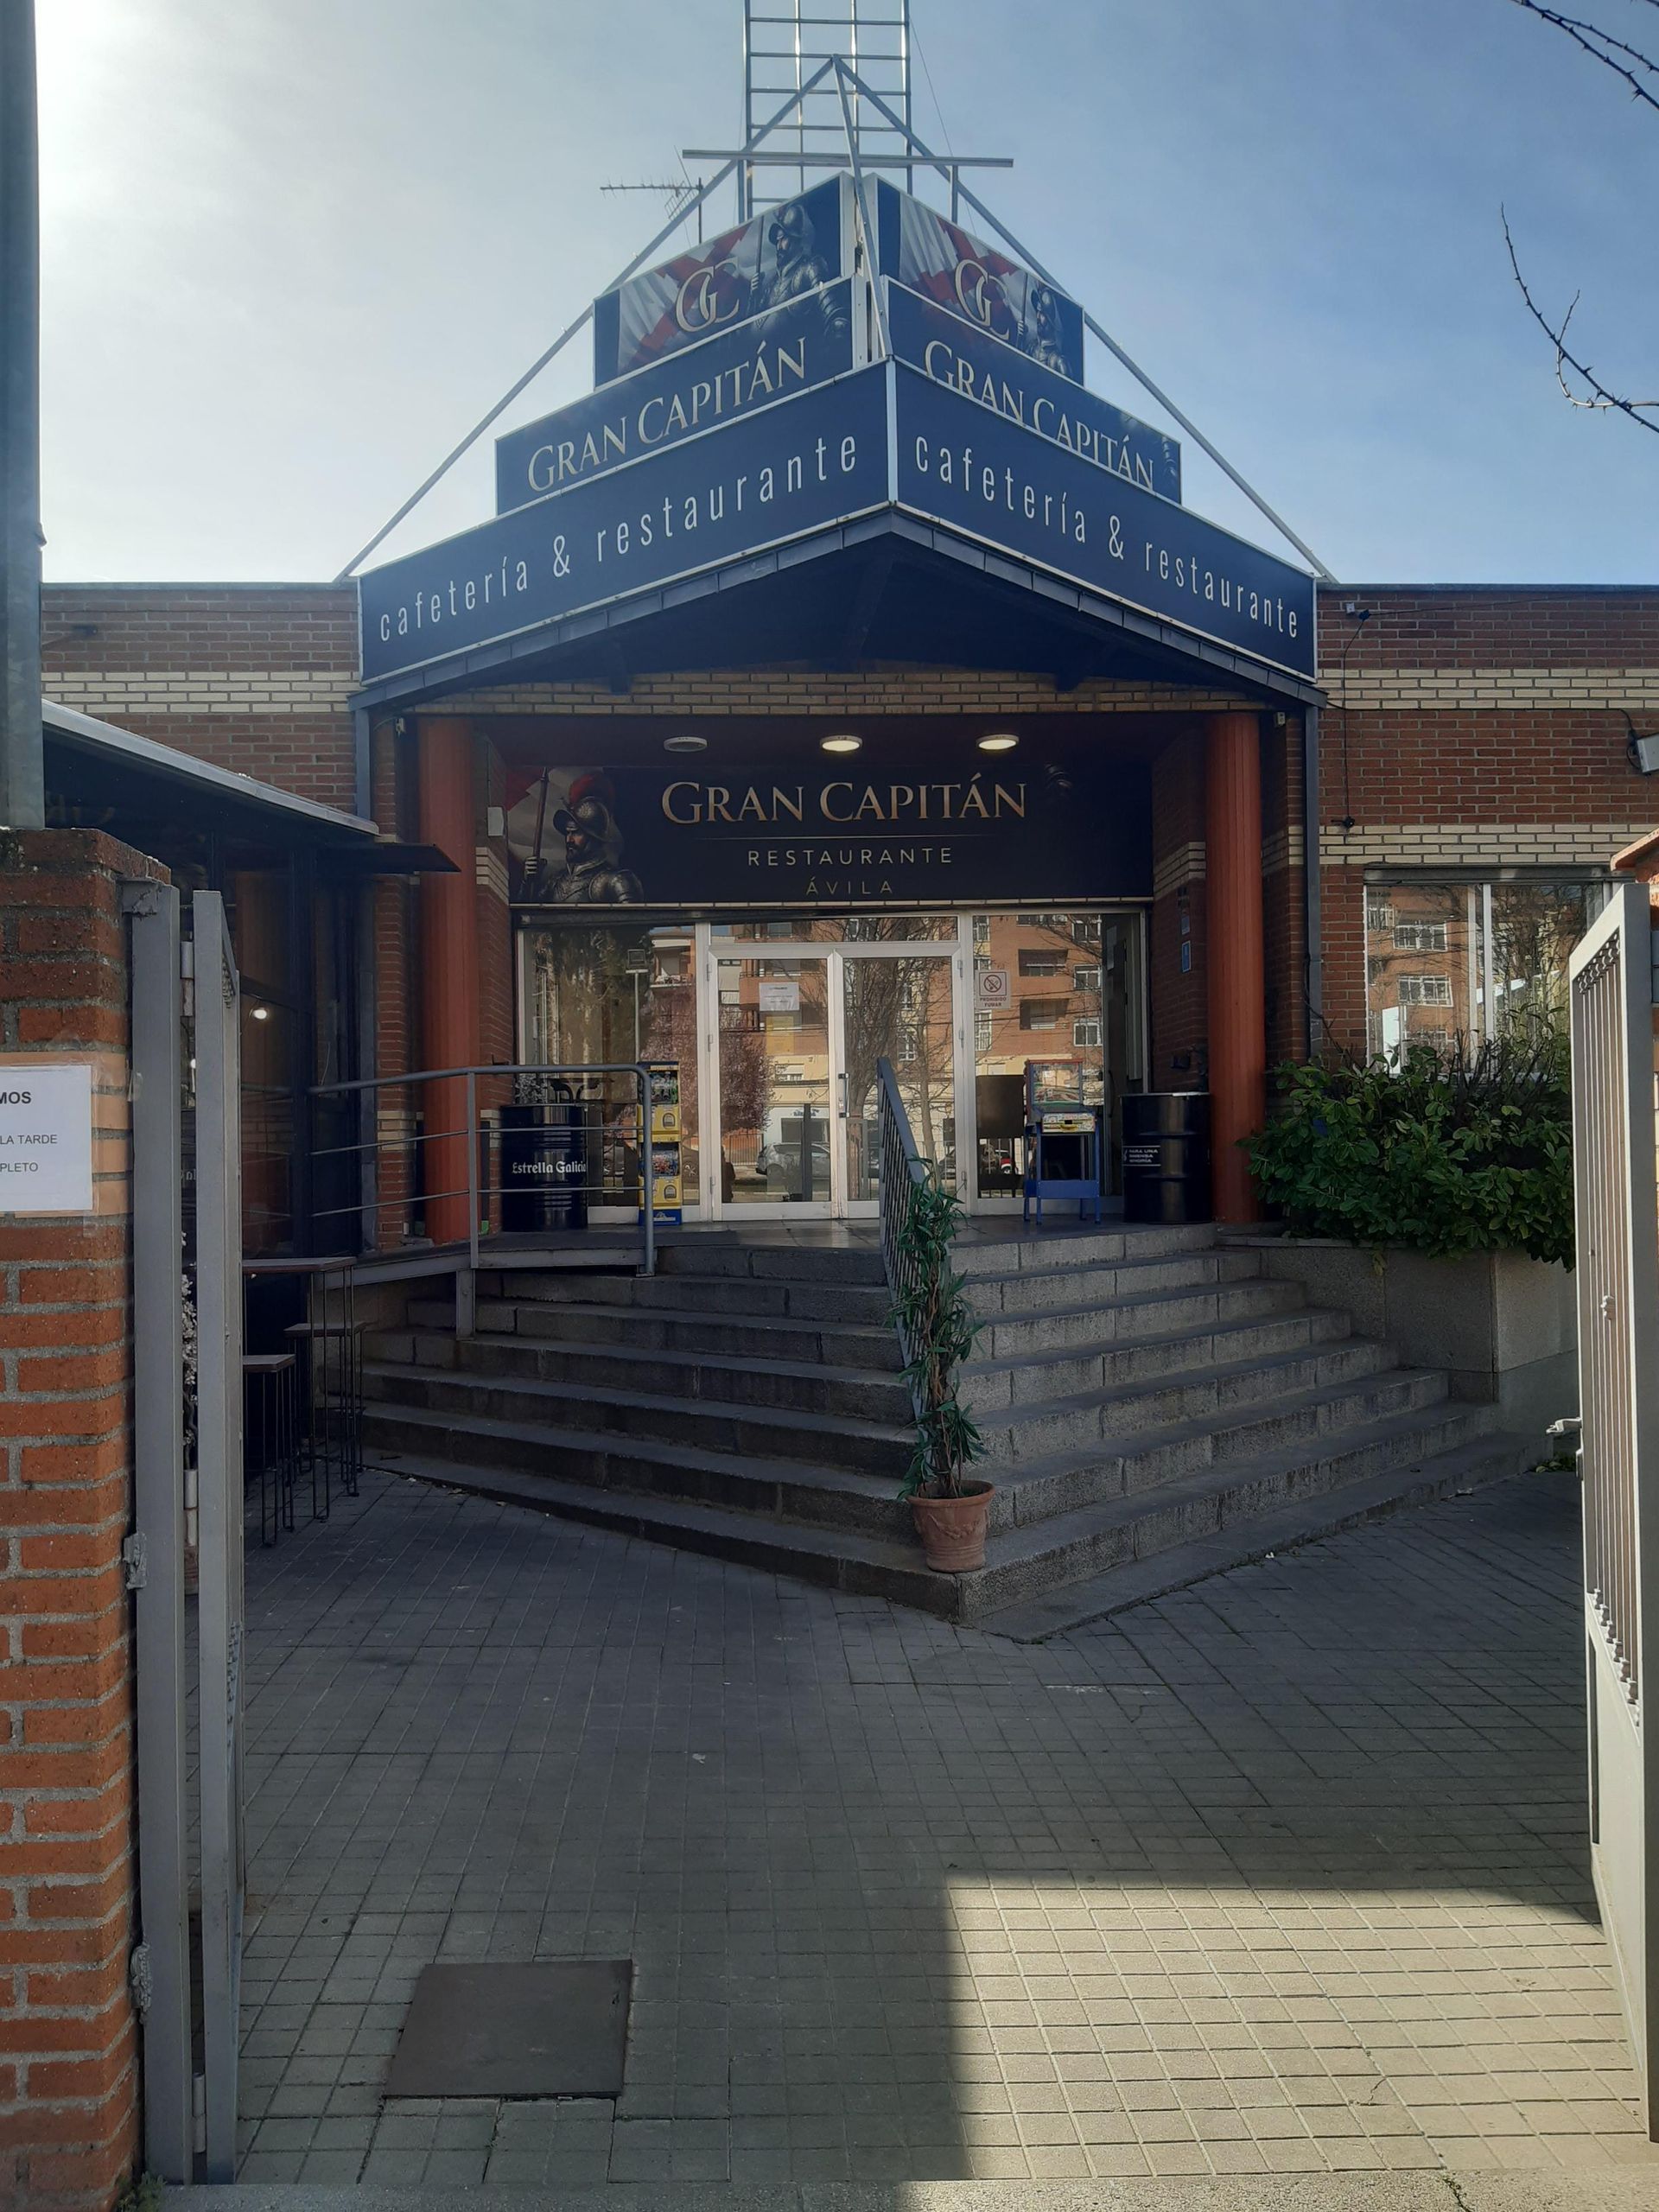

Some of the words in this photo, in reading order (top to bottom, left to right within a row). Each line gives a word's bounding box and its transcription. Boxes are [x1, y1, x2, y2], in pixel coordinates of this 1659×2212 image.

[527, 416, 627, 493] GRAN
[637, 337, 807, 445] CAPITÁN
[924, 340, 1026, 427] GRAN
[1033, 397, 1154, 493] CAPITÁN
[380, 556, 528, 642] cafetería
[552, 534, 571, 578] &
[596, 435, 857, 563] restaurante
[916, 435, 1086, 544] cafetería
[1109, 514, 1125, 560] &
[1145, 539, 1298, 639] restaurante
[661, 780, 804, 825] GRAN
[819, 771, 1027, 822] CAPITÁN
[747, 847, 954, 867] RESTAURANTE
[804, 875, 894, 896] ÁVILA
[0, 1135, 14, 1145] LA
[17, 1135, 58, 1144] TARDE
[0, 1162, 39, 1173] PLETO
[512, 1162, 553, 1173] Estrella
[556, 1161, 587, 1173] Galicia
